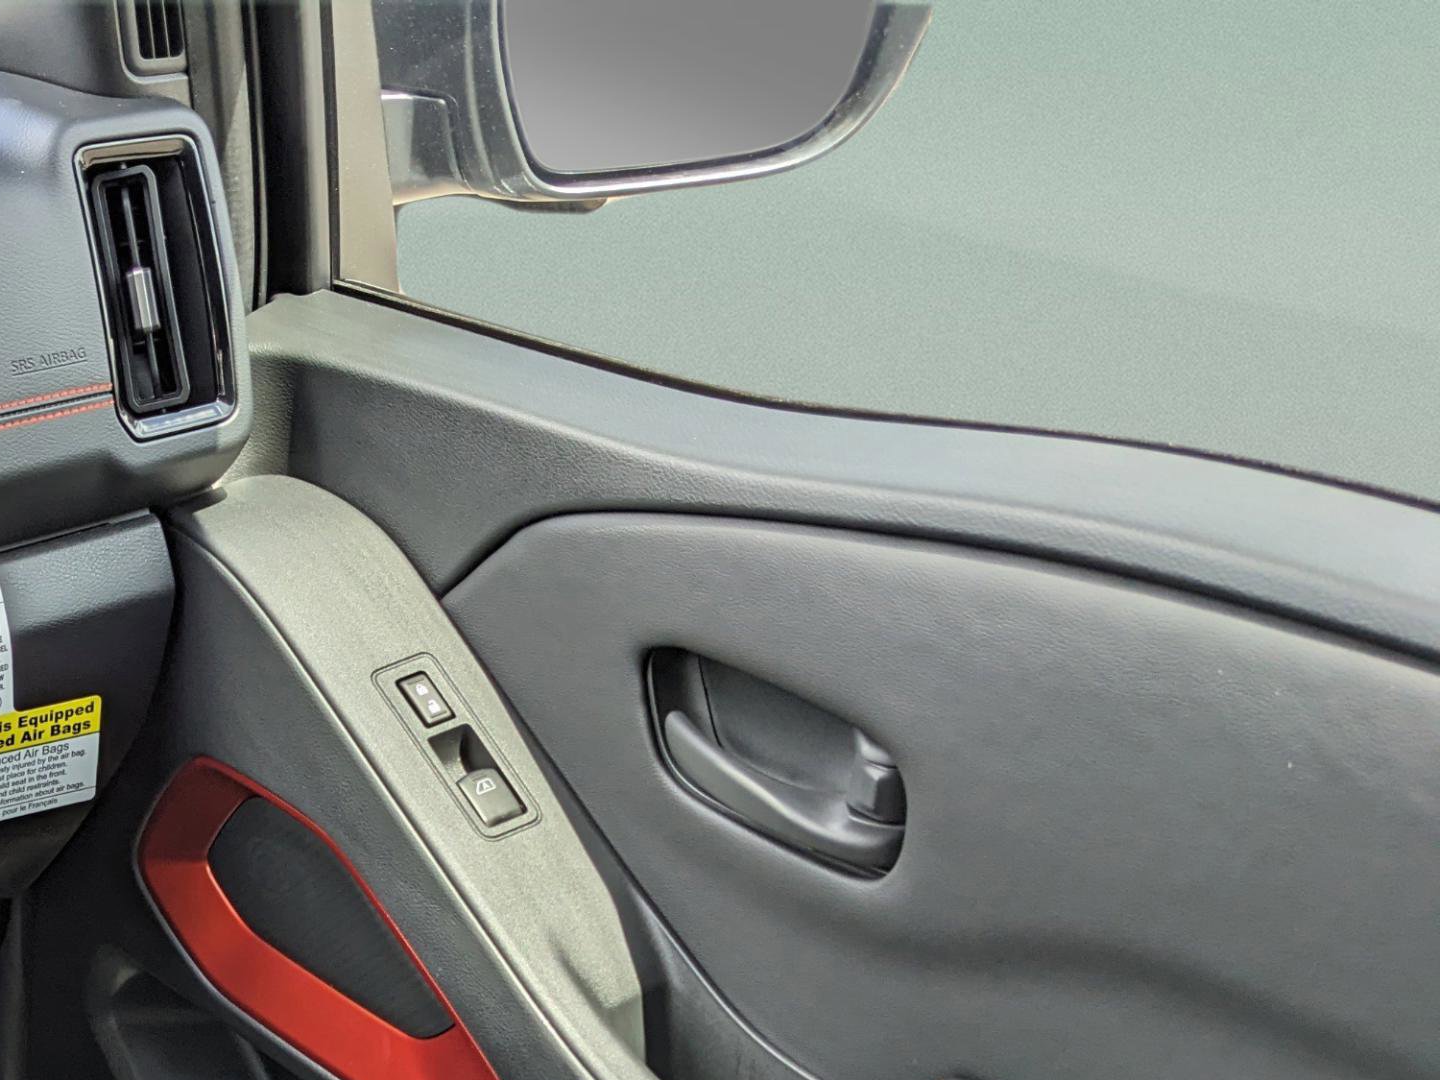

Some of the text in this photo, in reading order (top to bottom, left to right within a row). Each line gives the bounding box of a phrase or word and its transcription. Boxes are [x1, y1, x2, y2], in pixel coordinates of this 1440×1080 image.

[10, 347, 87, 374] SRS AIRBAG
[18, 701, 95, 728] Equipped
[20, 729, 45, 743] Air
[50, 720, 91, 737] Bags
[23, 748, 39, 760] Air
[42, 743, 70, 756] Bags
[11, 758, 36, 771] injured
[37, 756, 46, 767] by
[47, 754, 59, 763] the
[60, 752, 70, 760] air
[6, 769, 25, 781] place
[27, 766, 37, 776] for
[11, 777, 27, 787] seat
[36, 773, 48, 782] the
[8, 784, 25, 794] child
[34, 786, 55, 798] about
[56, 785, 65, 793] air
